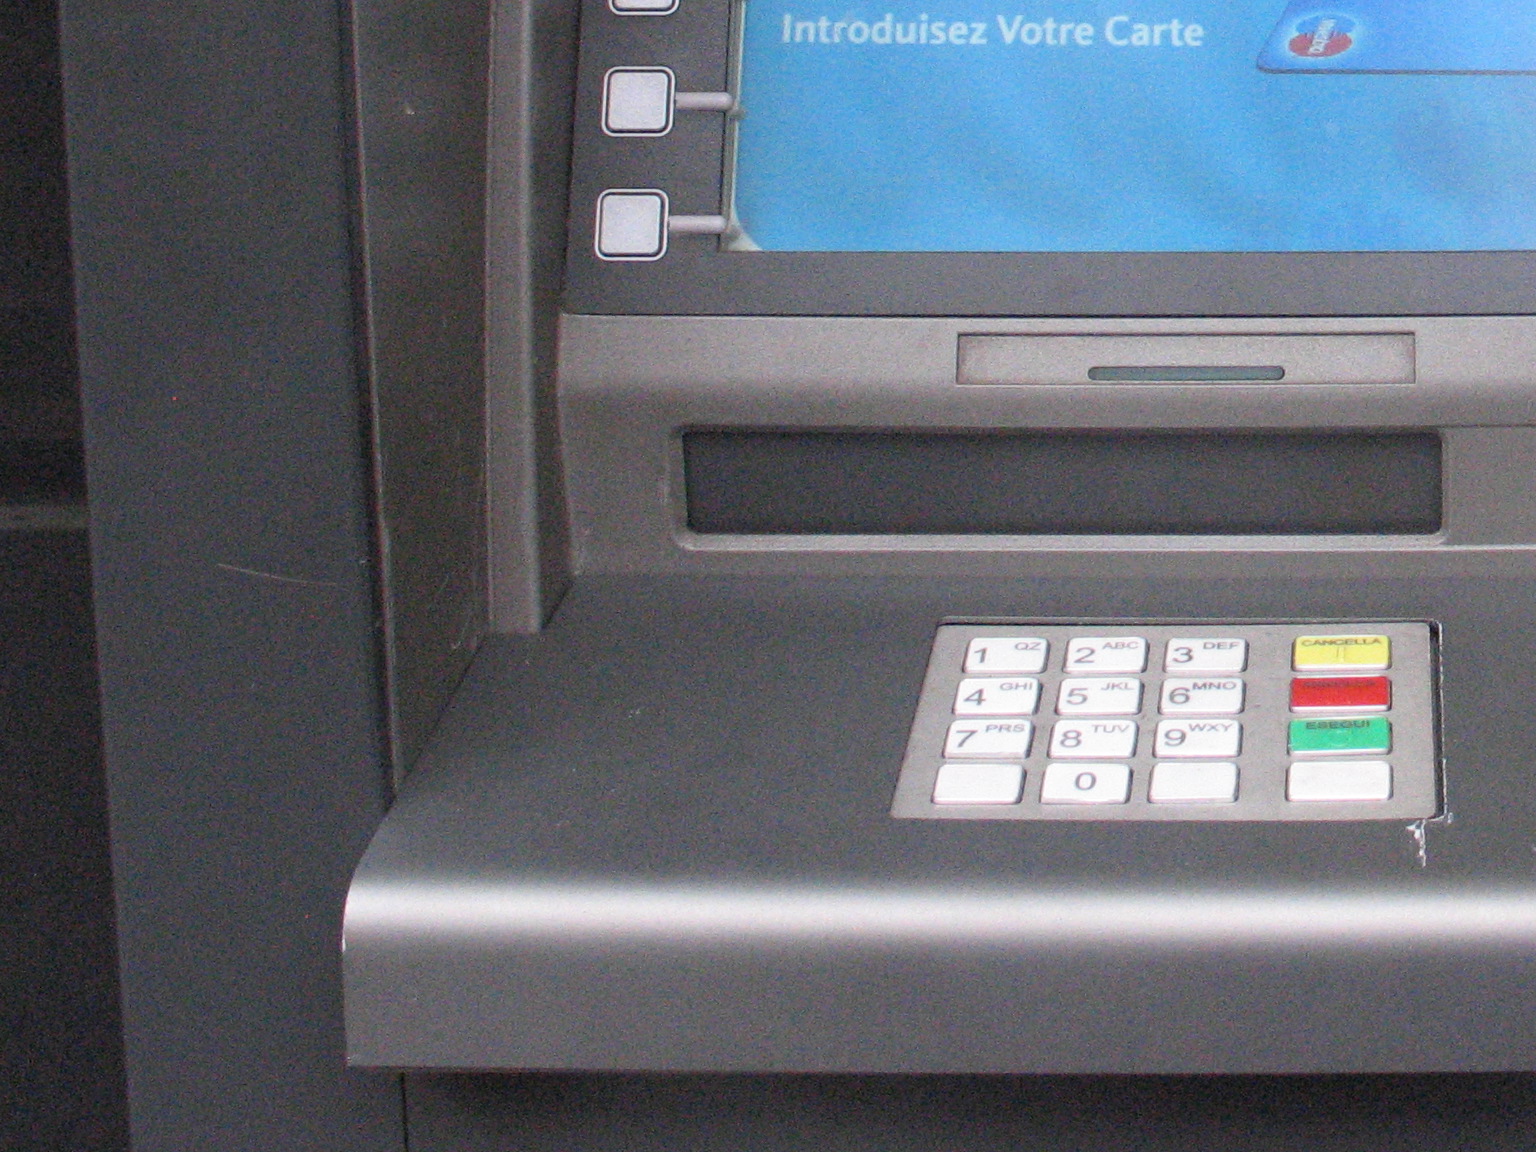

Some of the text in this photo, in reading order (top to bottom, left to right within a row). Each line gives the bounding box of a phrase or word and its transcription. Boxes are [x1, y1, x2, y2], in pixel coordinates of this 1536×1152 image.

[781, 12, 1205, 48] Introduisez Votre Carte
[973, 641, 1042, 664] 1 QZ
[1073, 641, 1139, 664] 2 ABC
[1172, 641, 1241, 663] 3 DEF
[1301, 637, 1382, 647] CANCELLA
[963, 682, 1033, 706] 4 GHI
[1066, 682, 1135, 706] 5 JKL
[1169, 681, 1237, 705] 6 MNO
[956, 723, 1025, 748] 7 PRS
[1059, 724, 1130, 748] 8 TUV
[1164, 723, 1233, 747] 9 WXY
[1305, 719, 1371, 730] ESEGUI
[1074, 772, 1097, 791] 0
